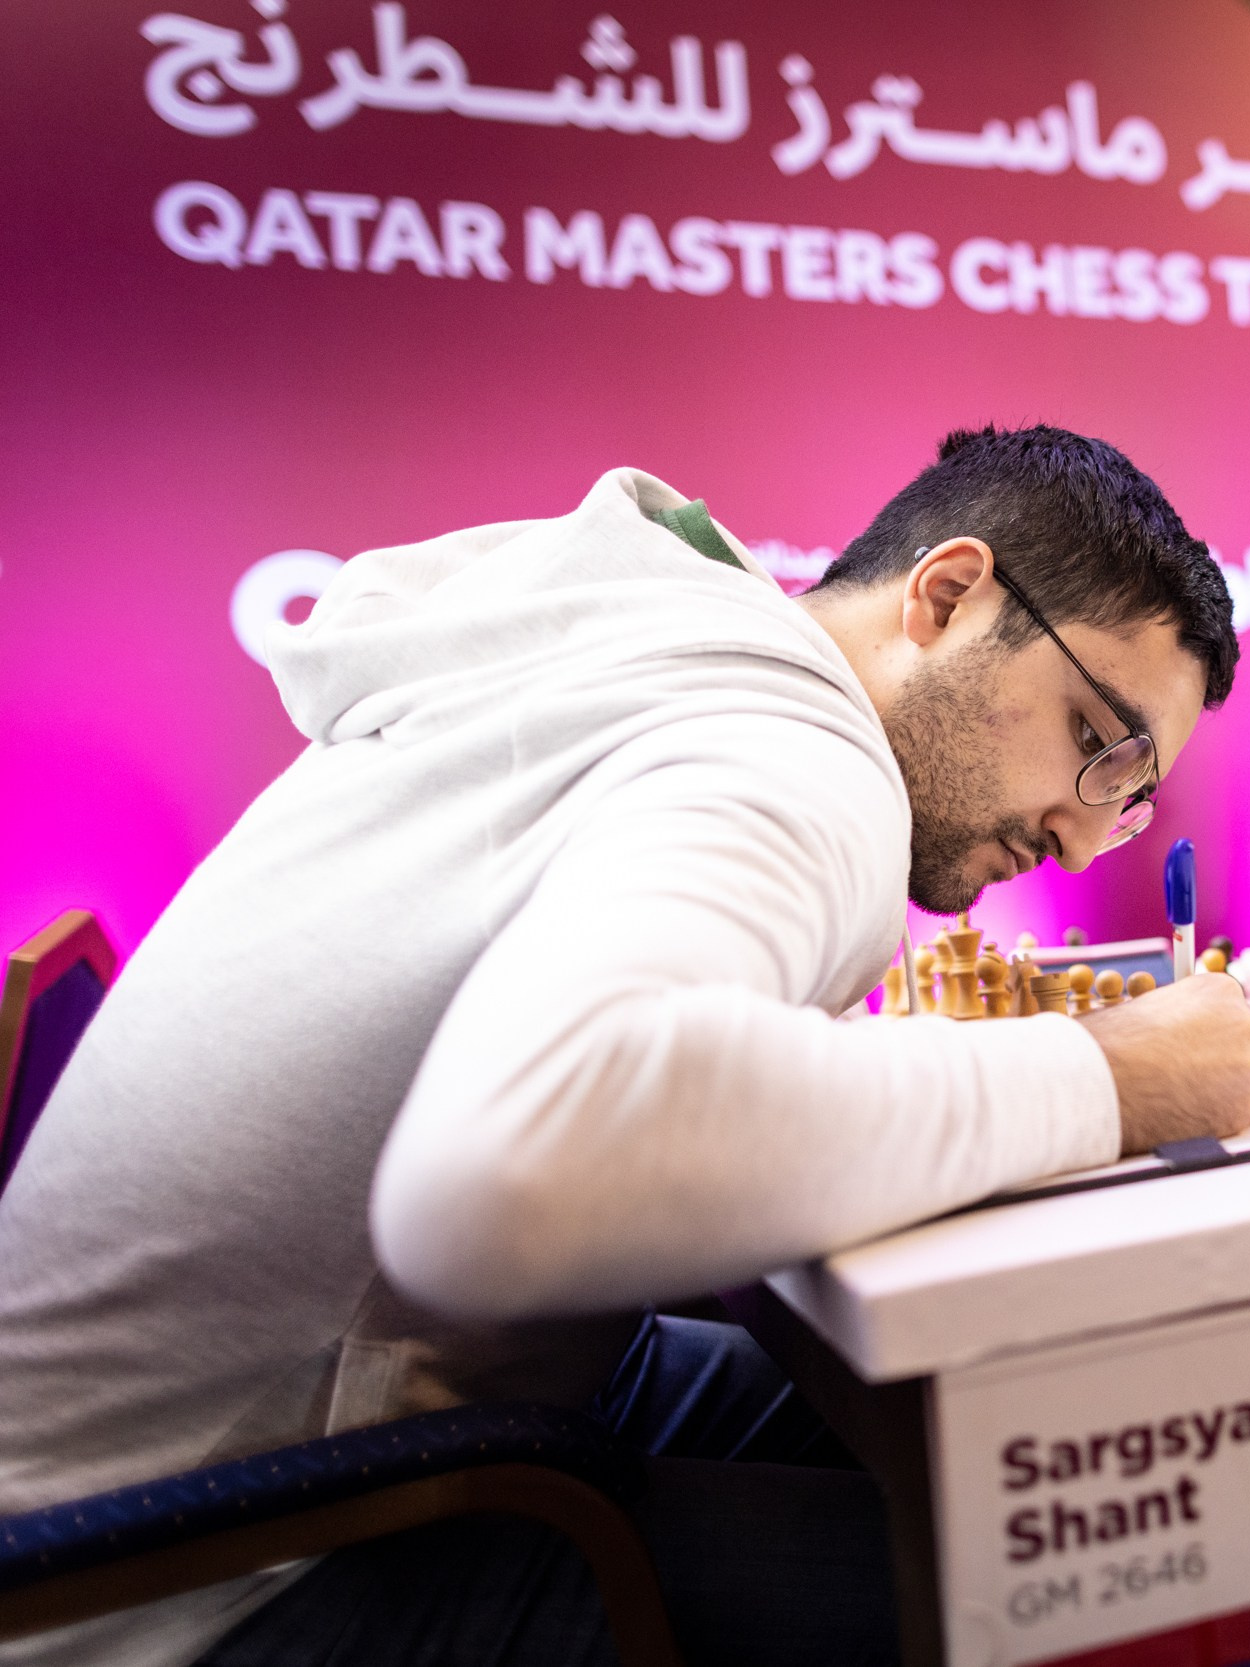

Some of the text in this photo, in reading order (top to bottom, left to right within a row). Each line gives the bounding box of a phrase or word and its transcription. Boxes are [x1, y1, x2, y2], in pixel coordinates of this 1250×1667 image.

[141, 0, 750, 141] للشطرنج
[772, 54, 1168, 181] ماسترز
[154, 182, 510, 281] QATAR
[523, 205, 943, 310] MASTERS
[949, 236, 1210, 325] CHESS
[1005, 1474, 1202, 1565] Shant
[1006, 1541, 1208, 1628] GM 2646
